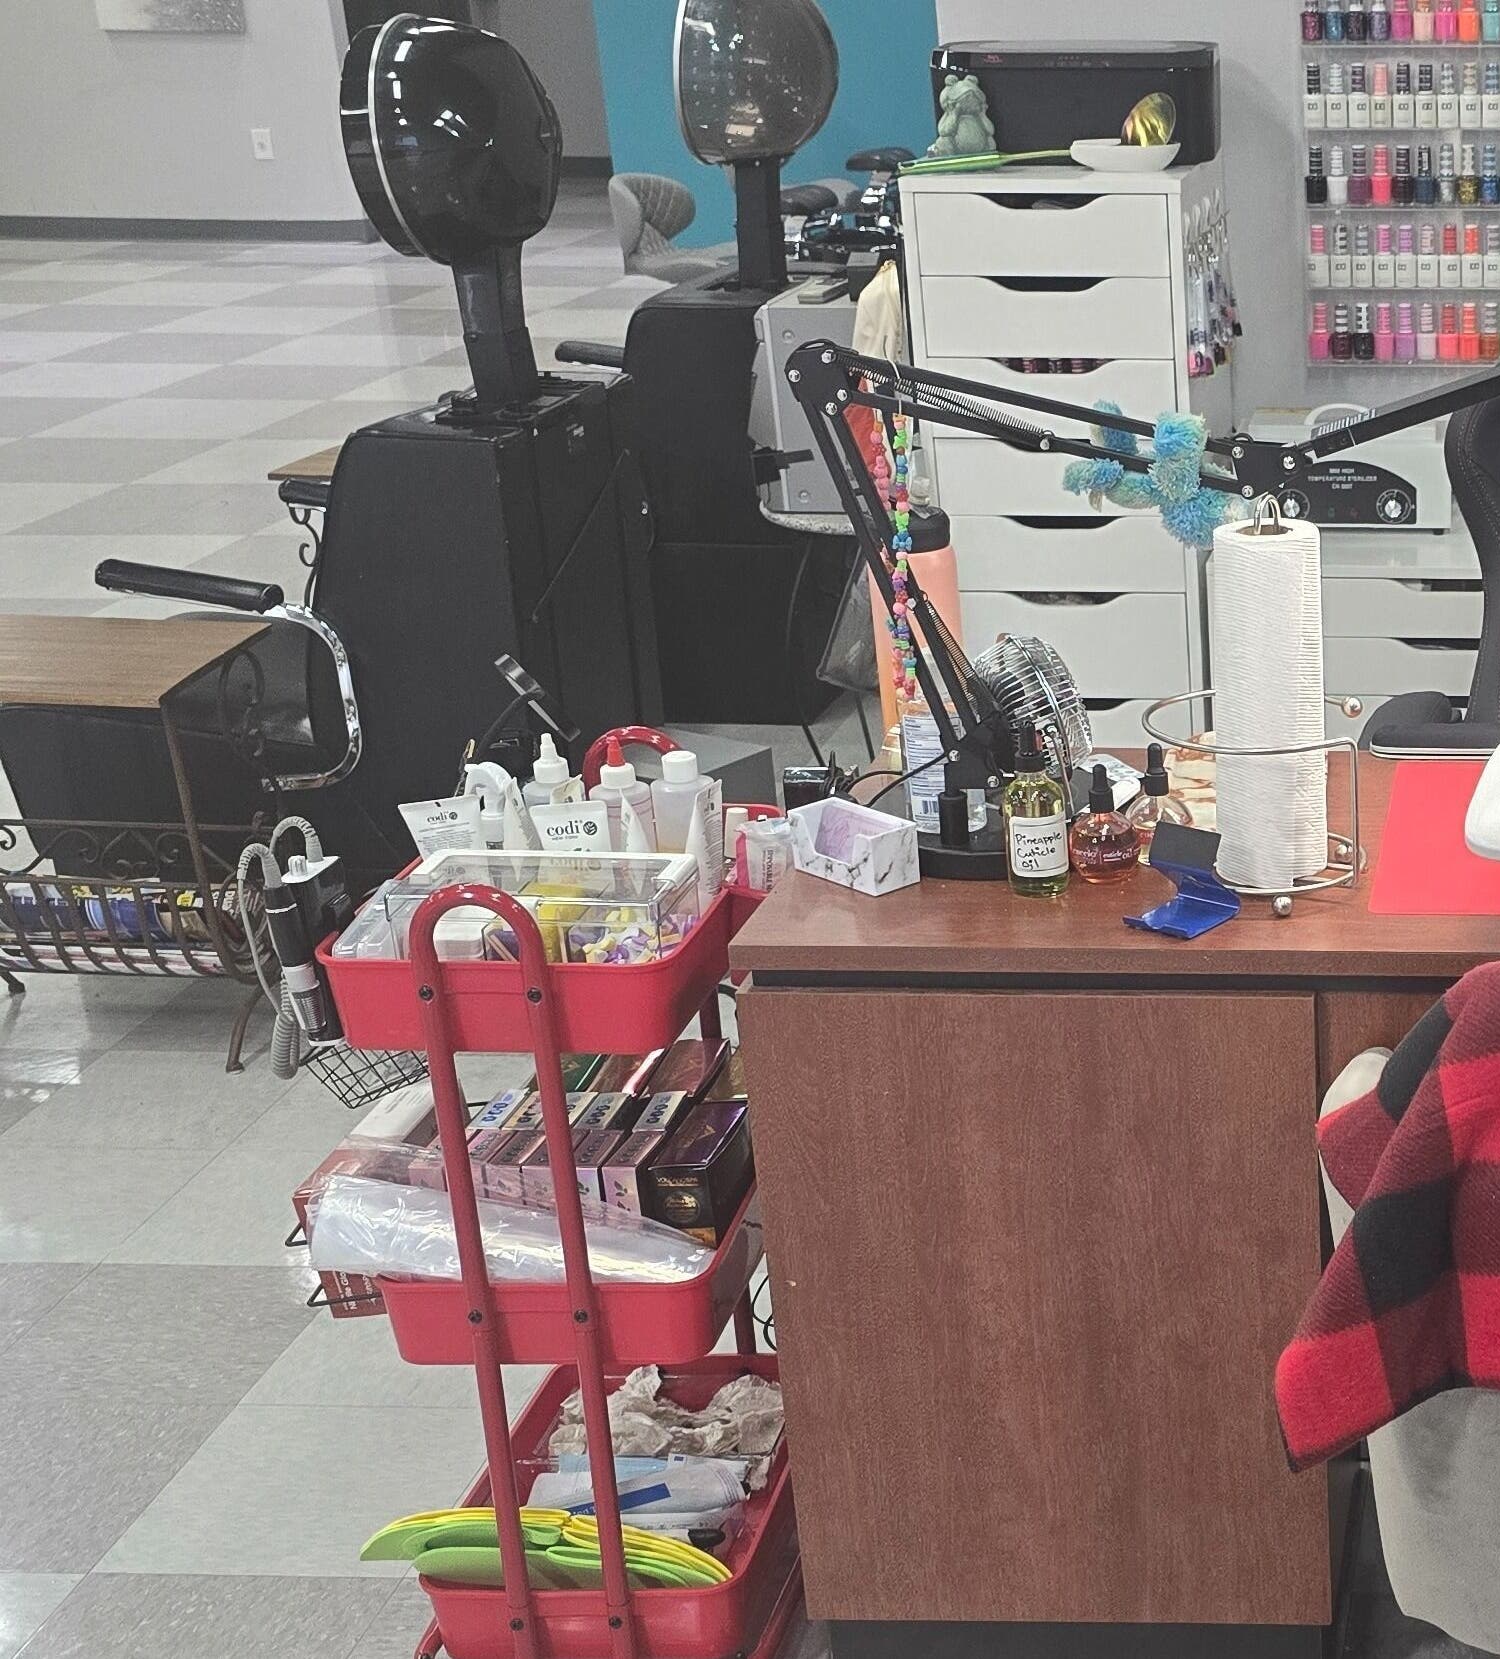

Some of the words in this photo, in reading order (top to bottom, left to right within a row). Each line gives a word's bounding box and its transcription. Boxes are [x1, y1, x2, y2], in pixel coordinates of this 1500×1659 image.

[427, 811, 448, 823] codi
[546, 820, 580, 836] codi
[1014, 831, 1063, 846] Pineapple
[1017, 847, 1056, 859] Cuticle
